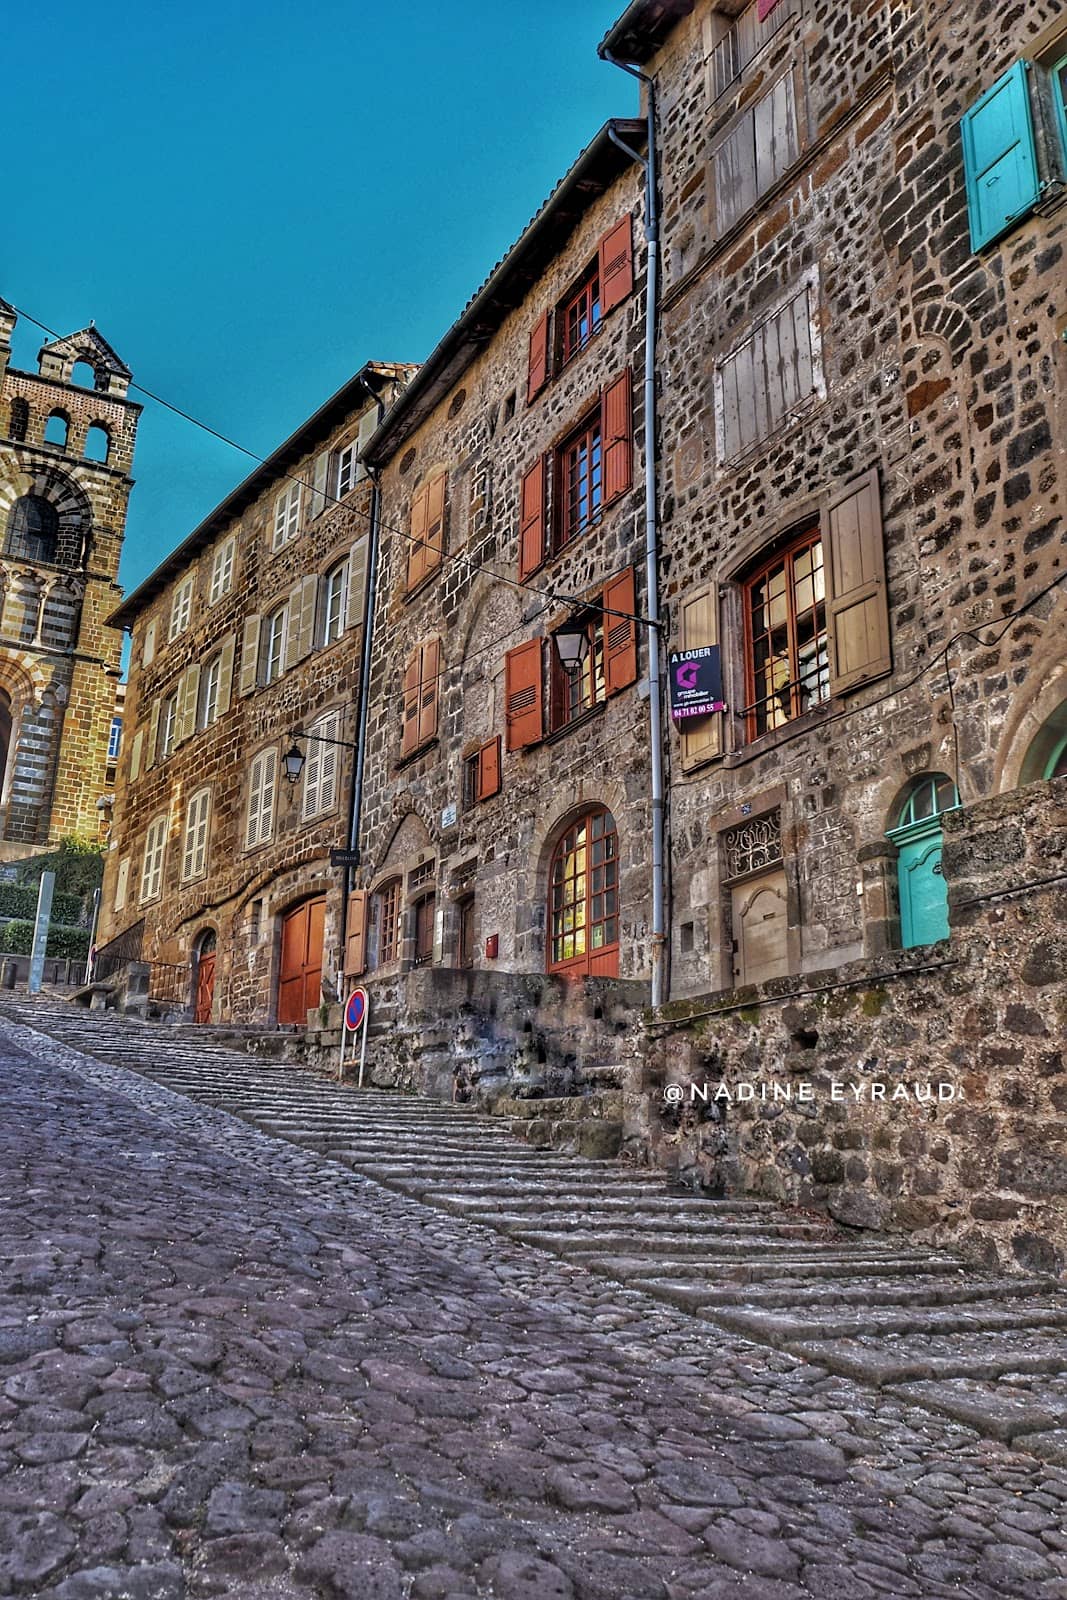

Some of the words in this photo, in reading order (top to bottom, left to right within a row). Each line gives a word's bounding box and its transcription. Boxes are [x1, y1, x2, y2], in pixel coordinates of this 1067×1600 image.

[671, 653, 679, 663] A
[680, 647, 711, 661] LOUER
[682, 707, 689, 716] 71
[706, 703, 714, 711] 55
